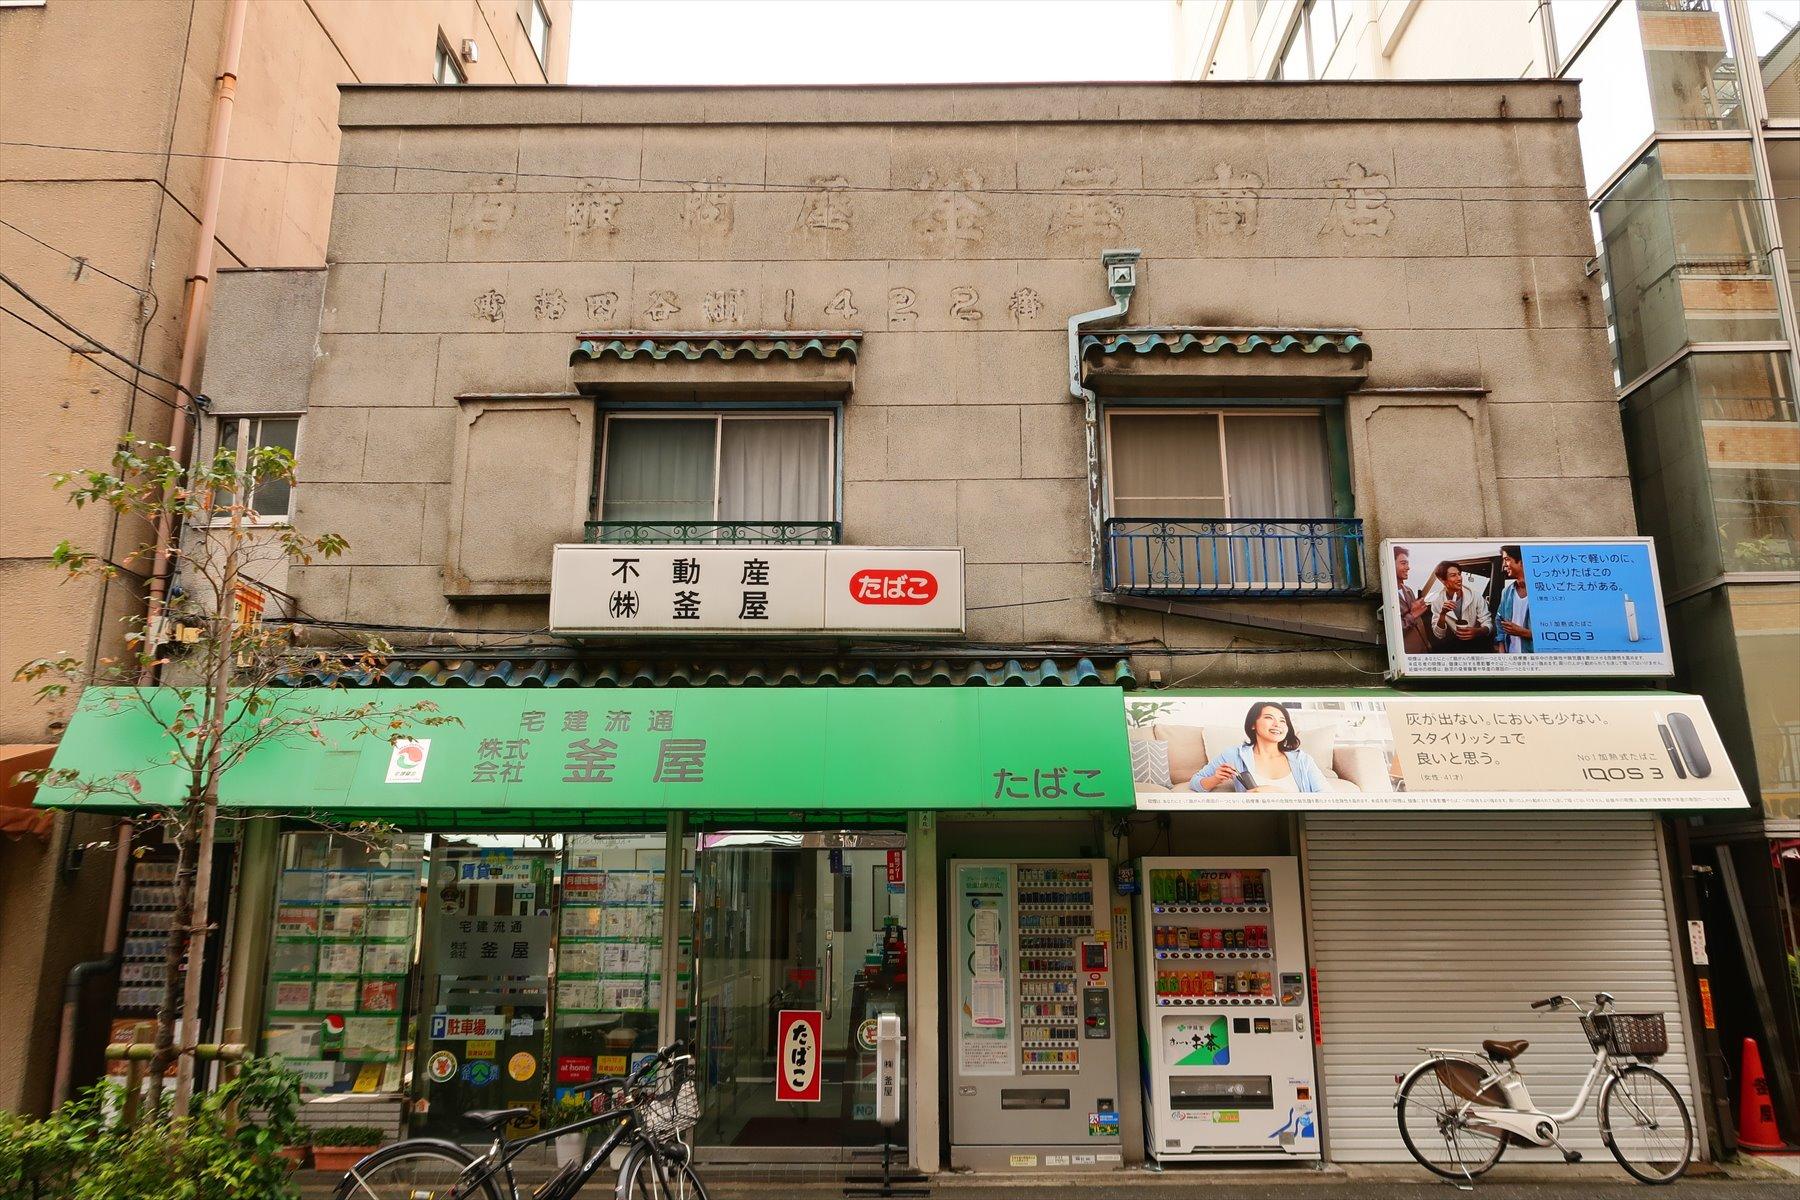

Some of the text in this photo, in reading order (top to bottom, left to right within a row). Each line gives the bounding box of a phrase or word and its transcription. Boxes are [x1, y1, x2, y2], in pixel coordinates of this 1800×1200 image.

[1531, 554, 1635, 564] コンパクトで軽いのに、
[611, 557, 770, 586] 不動産
[1532, 568, 1612, 578] しっかりたばこの
[857, 574, 931, 600] たばこ
[1534, 581, 1624, 592] 吸いごたえがある。
[1541, 631, 1595, 642] IQOS 3
[520, 710, 673, 733] 宅建流通
[1405, 712, 1610, 726] 灰が出ない。においも少ない。
[1410, 732, 1527, 745] スタイリッシュで
[562, 738, 706, 783] 釜屋
[1416, 751, 1501, 766] 良いと思う。
[1582, 767, 1664, 781] IQOS 3
[992, 766, 1106, 799] たばこ
[460, 920, 523, 934] 宅建流通
[481, 941, 529, 959] 釜屋
[433, 1018, 444, 1036] P
[446, 1018, 487, 1036] 駐車場
[791, 1024, 811, 1088] たばこ
[560, 1063, 570, 1072] at
[570, 1060, 591, 1072] home
